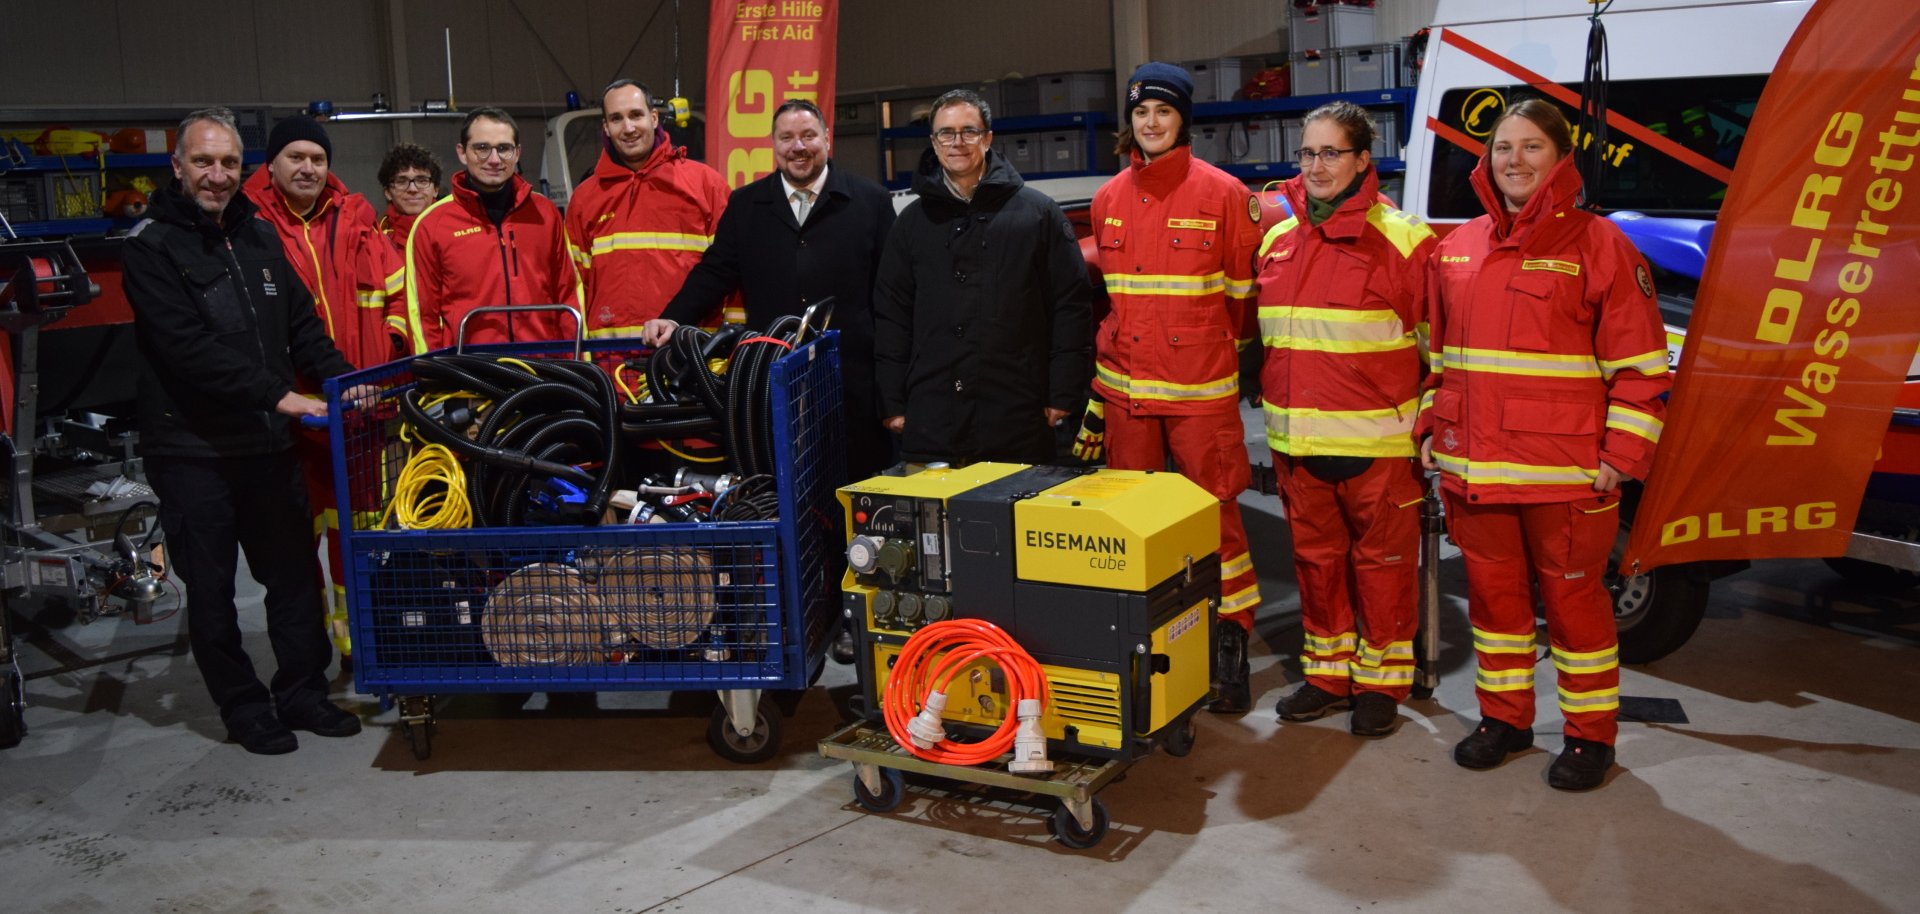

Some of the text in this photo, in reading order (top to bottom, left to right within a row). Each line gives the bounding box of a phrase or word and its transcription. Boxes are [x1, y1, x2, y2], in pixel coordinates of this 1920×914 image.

[736, 0, 823, 18] Erste Hilfe
[742, 24, 814, 41] First Aid
[1755, 111, 1864, 345] DLRG
[1766, 53, 1920, 446] Wasserrettu
[1660, 501, 1837, 547] DLRG
[1026, 530, 1126, 555] EISEMANN
[1089, 555, 1127, 571] cube
